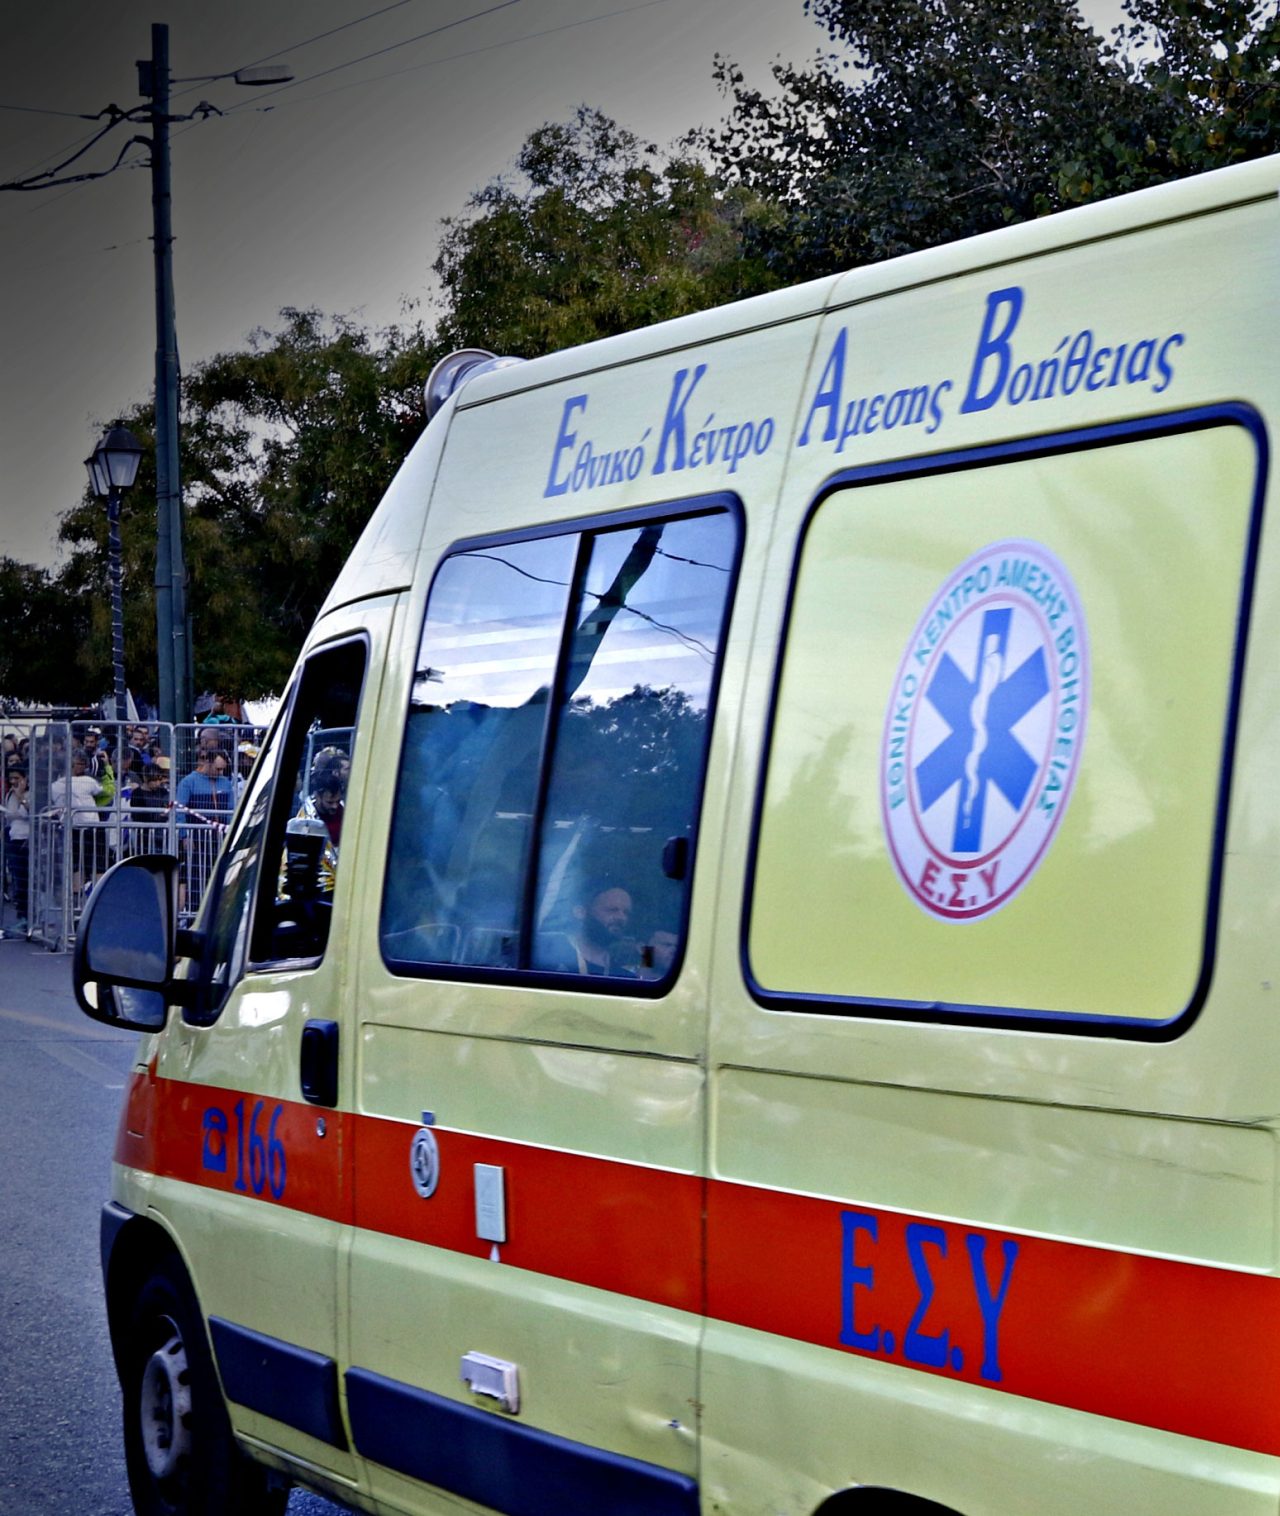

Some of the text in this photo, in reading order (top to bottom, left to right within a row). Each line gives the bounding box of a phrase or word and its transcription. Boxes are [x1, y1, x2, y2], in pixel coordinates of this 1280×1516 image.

[545, 286, 1186, 499] Εθνικό Κέντρο Αμεσης Βοήθειας
[233, 1098, 287, 1201] 166
